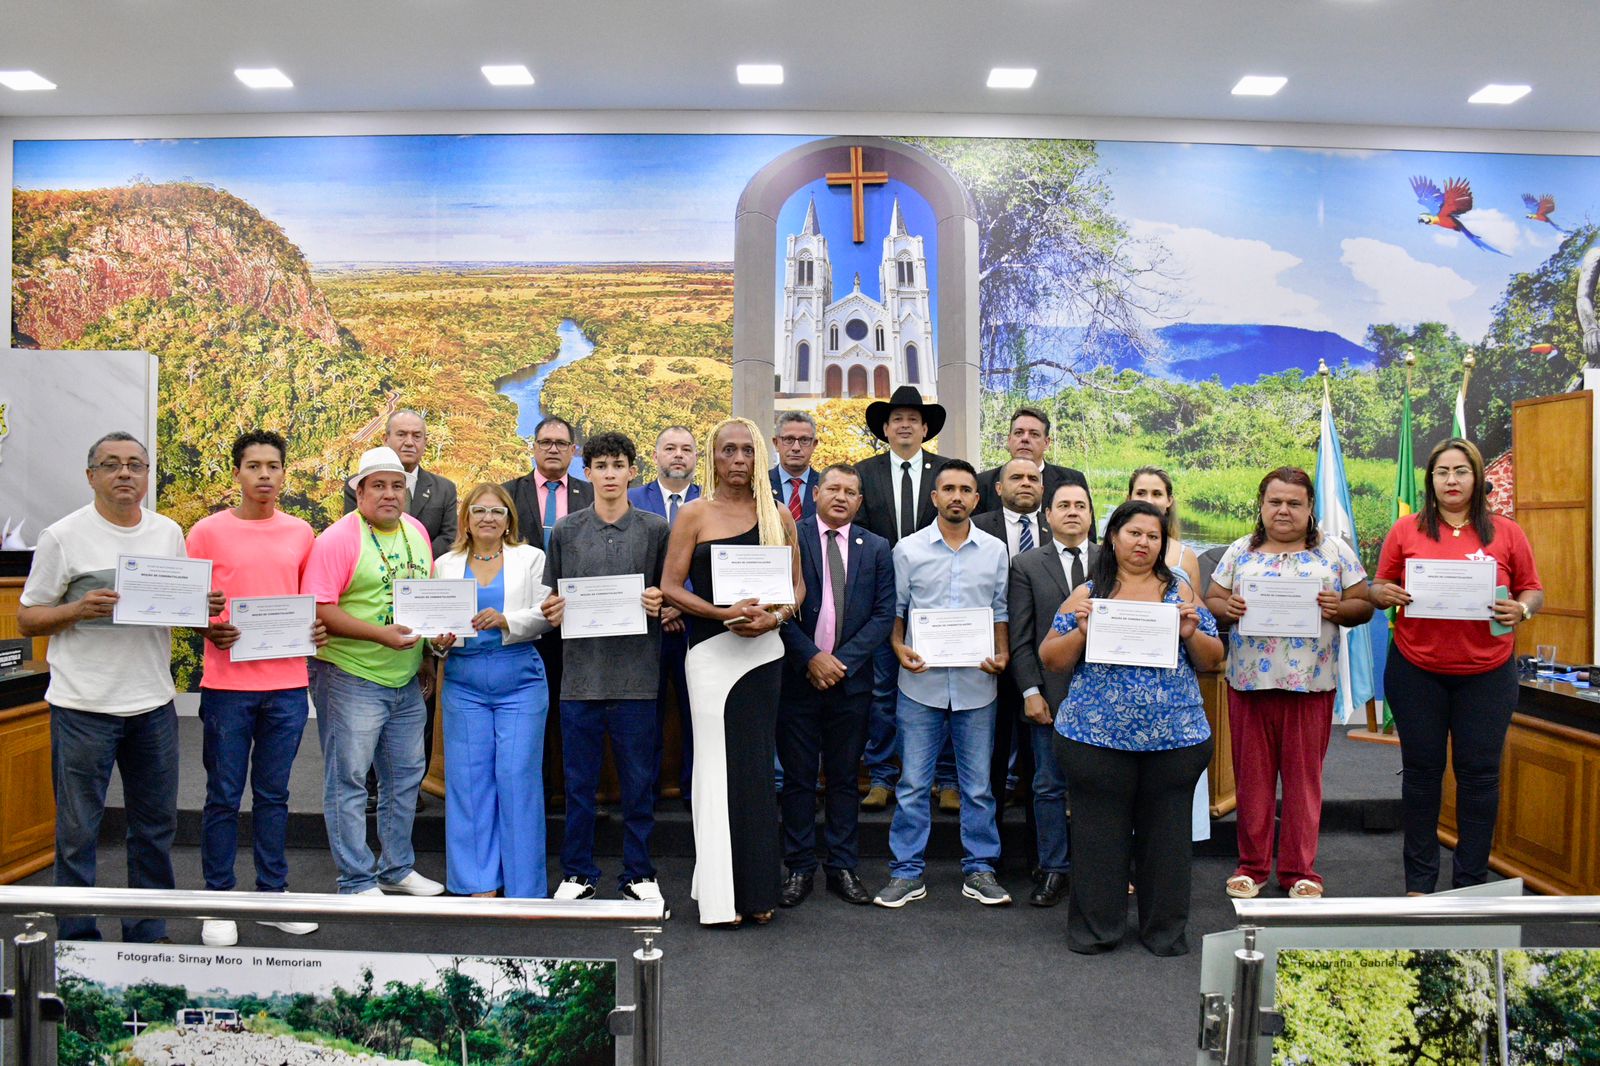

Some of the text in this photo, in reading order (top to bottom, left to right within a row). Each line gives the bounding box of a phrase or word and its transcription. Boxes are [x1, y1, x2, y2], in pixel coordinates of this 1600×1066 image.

[117, 951, 322, 967] Fotografia: Sirnay Moro In Memoriam
